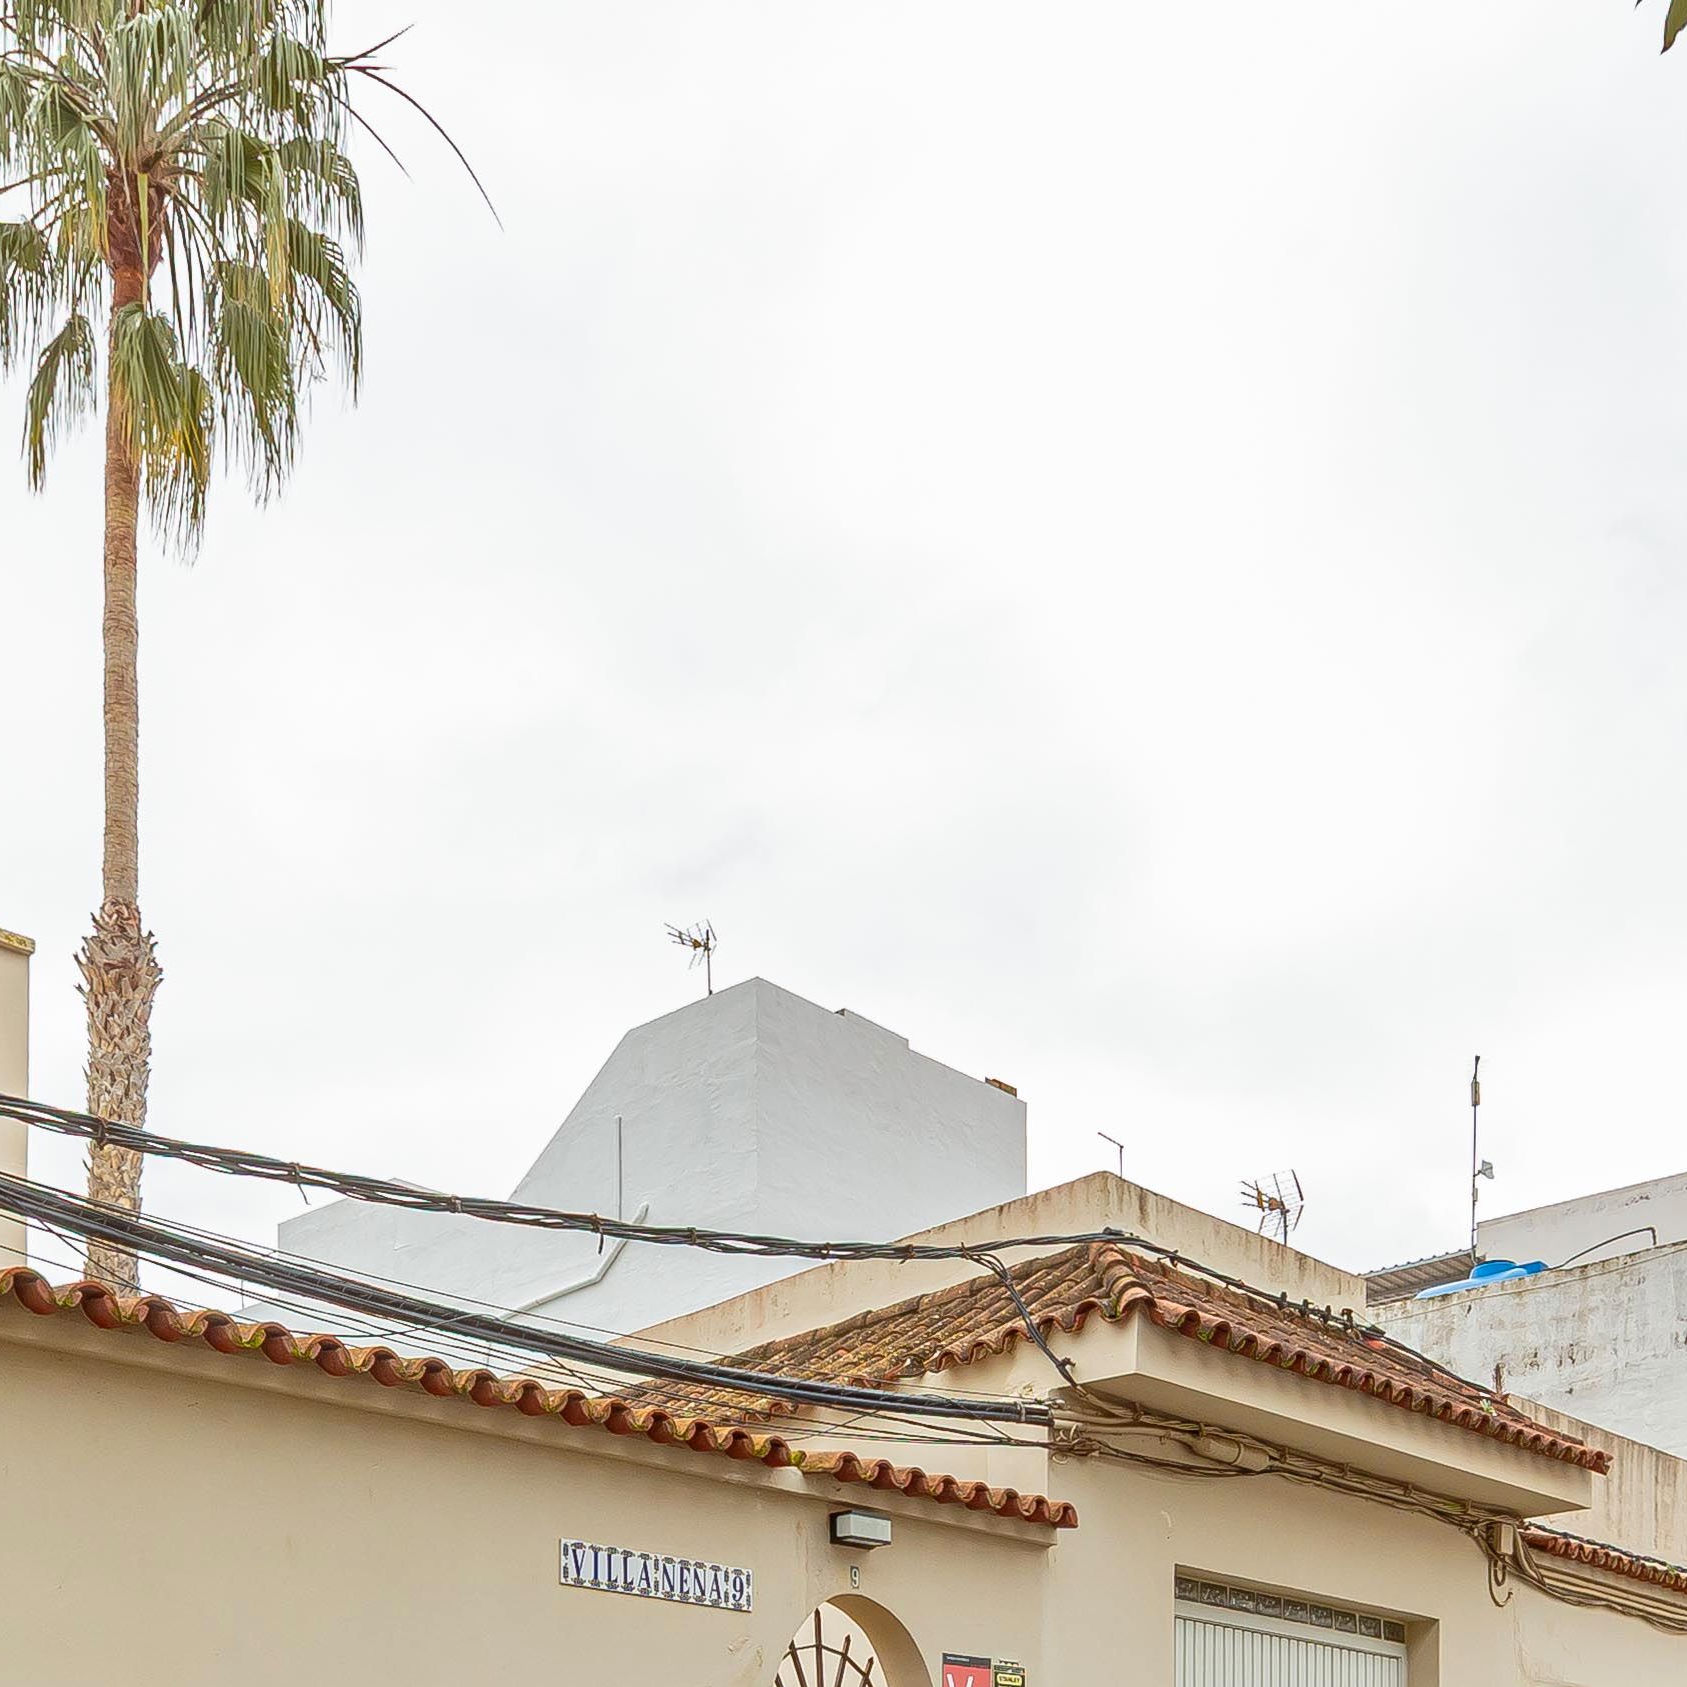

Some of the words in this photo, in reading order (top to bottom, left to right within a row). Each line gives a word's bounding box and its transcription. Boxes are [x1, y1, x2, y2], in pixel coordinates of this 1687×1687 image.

[571, 1548, 652, 1589] VILLA
[662, 1563, 722, 1600] NENA
[731, 1575, 745, 1602] 9
[851, 1568, 859, 1588] 9
